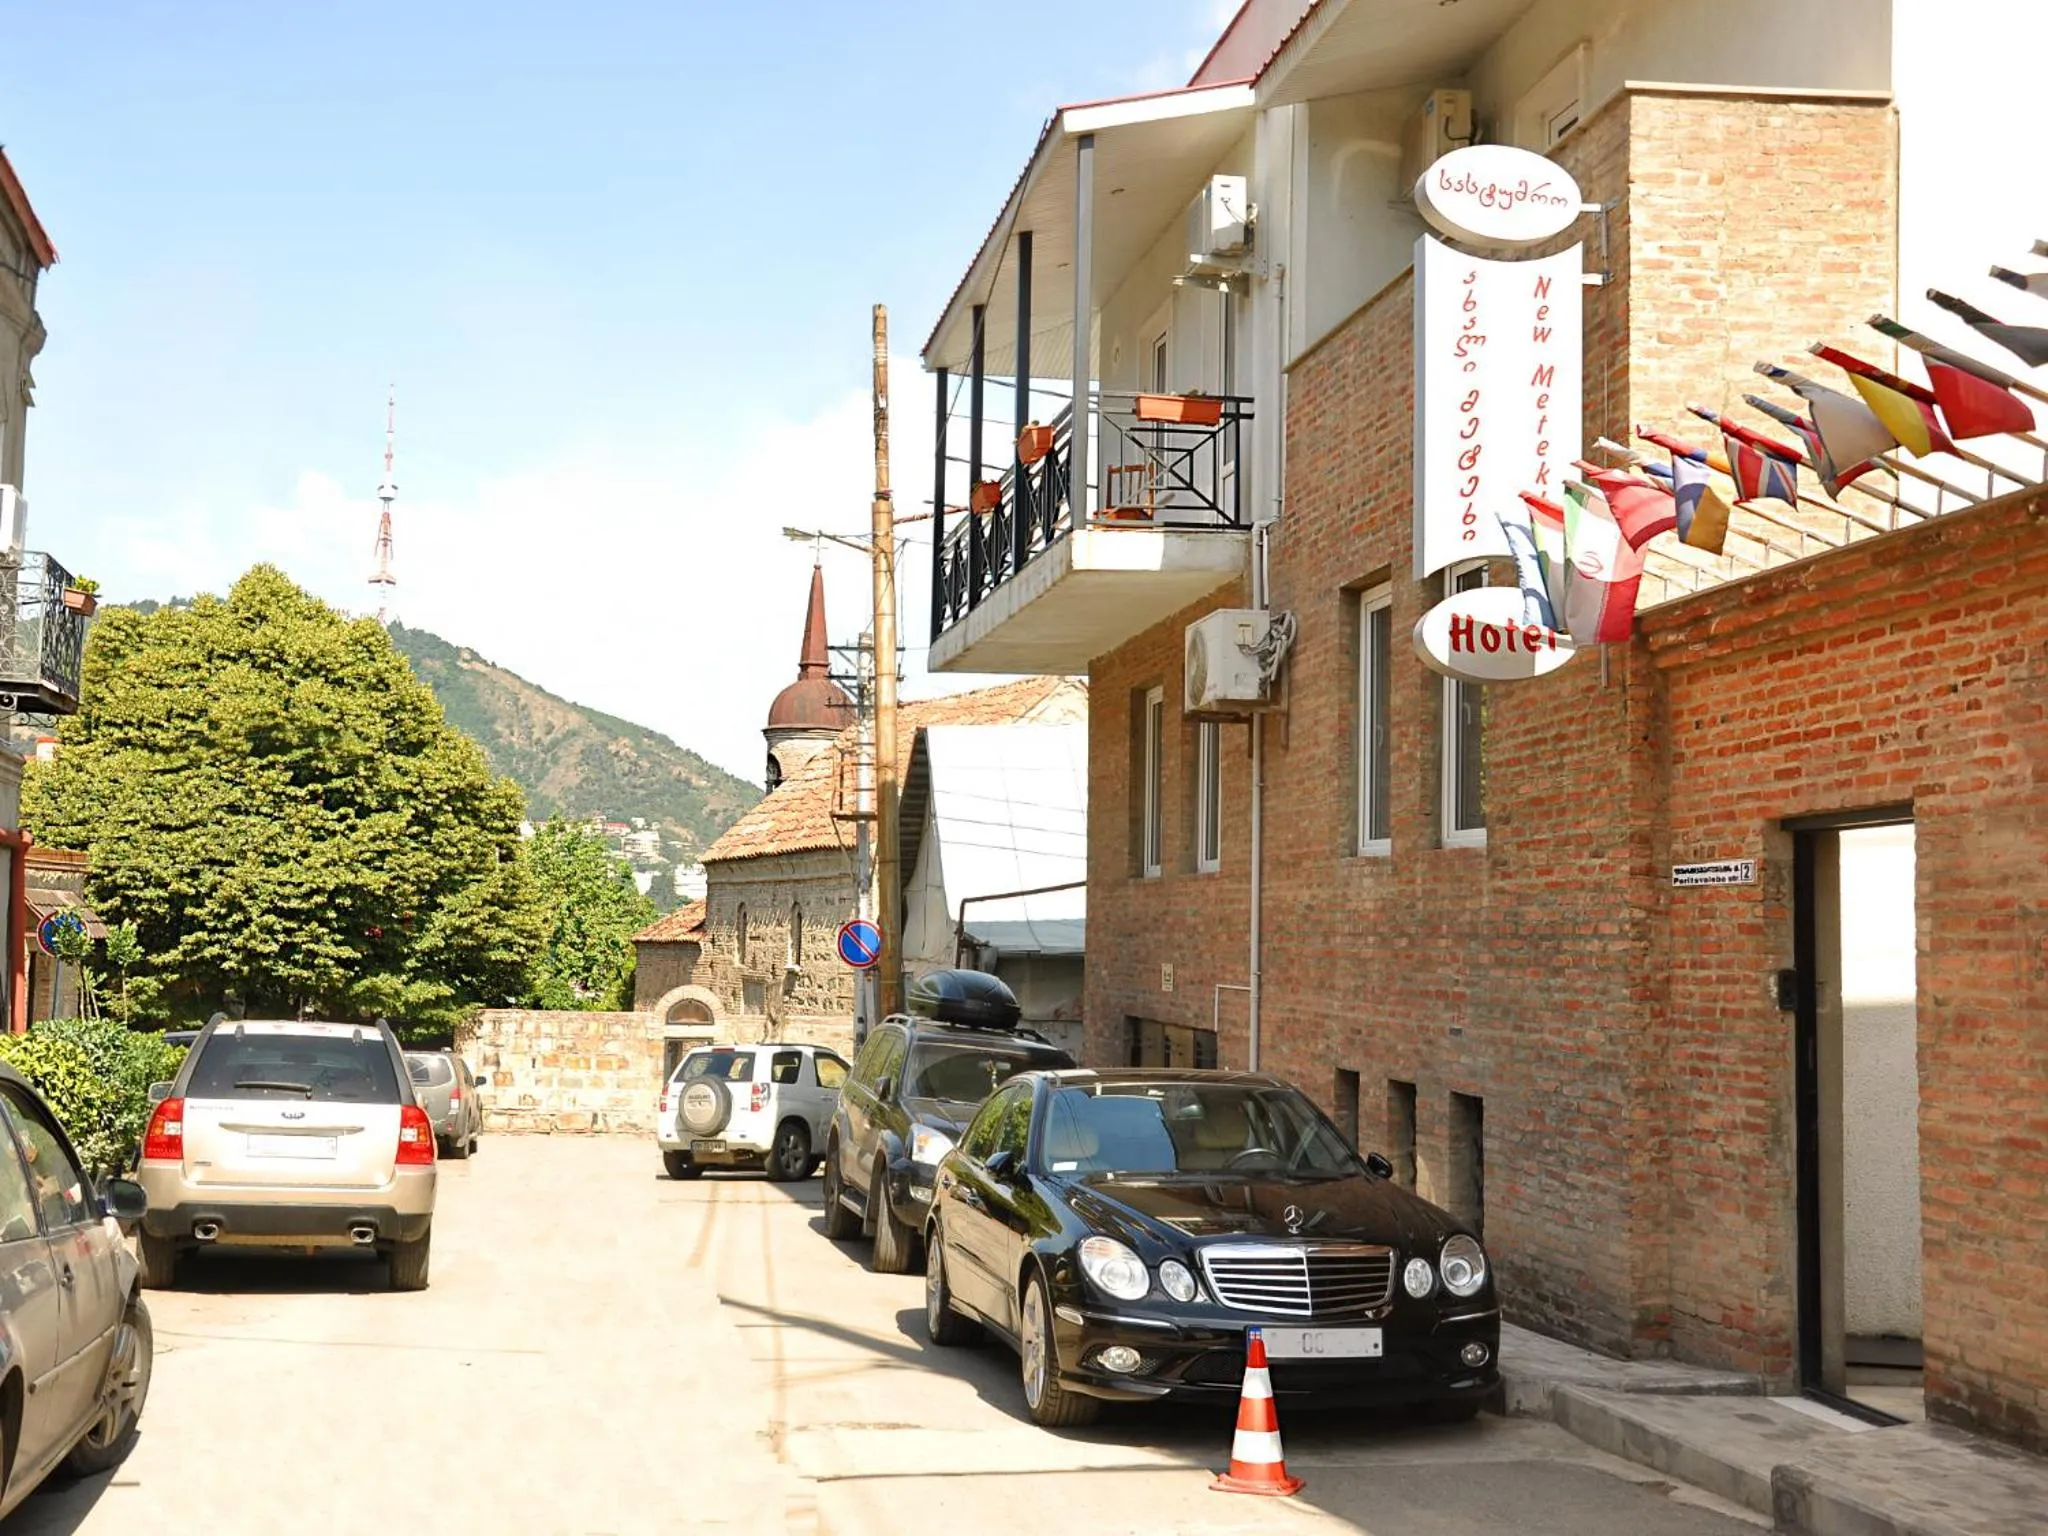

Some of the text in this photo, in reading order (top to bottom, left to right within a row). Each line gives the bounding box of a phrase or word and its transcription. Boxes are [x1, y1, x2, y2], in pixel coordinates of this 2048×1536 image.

[1440, 168, 1568, 210] სასტუმრო
[1532, 274, 1552, 344] New
[1453, 271, 1487, 542] ახალი მეტეხი
[1449, 612, 1556, 653] Hotel
[1744, 865, 1750, 878] 2
